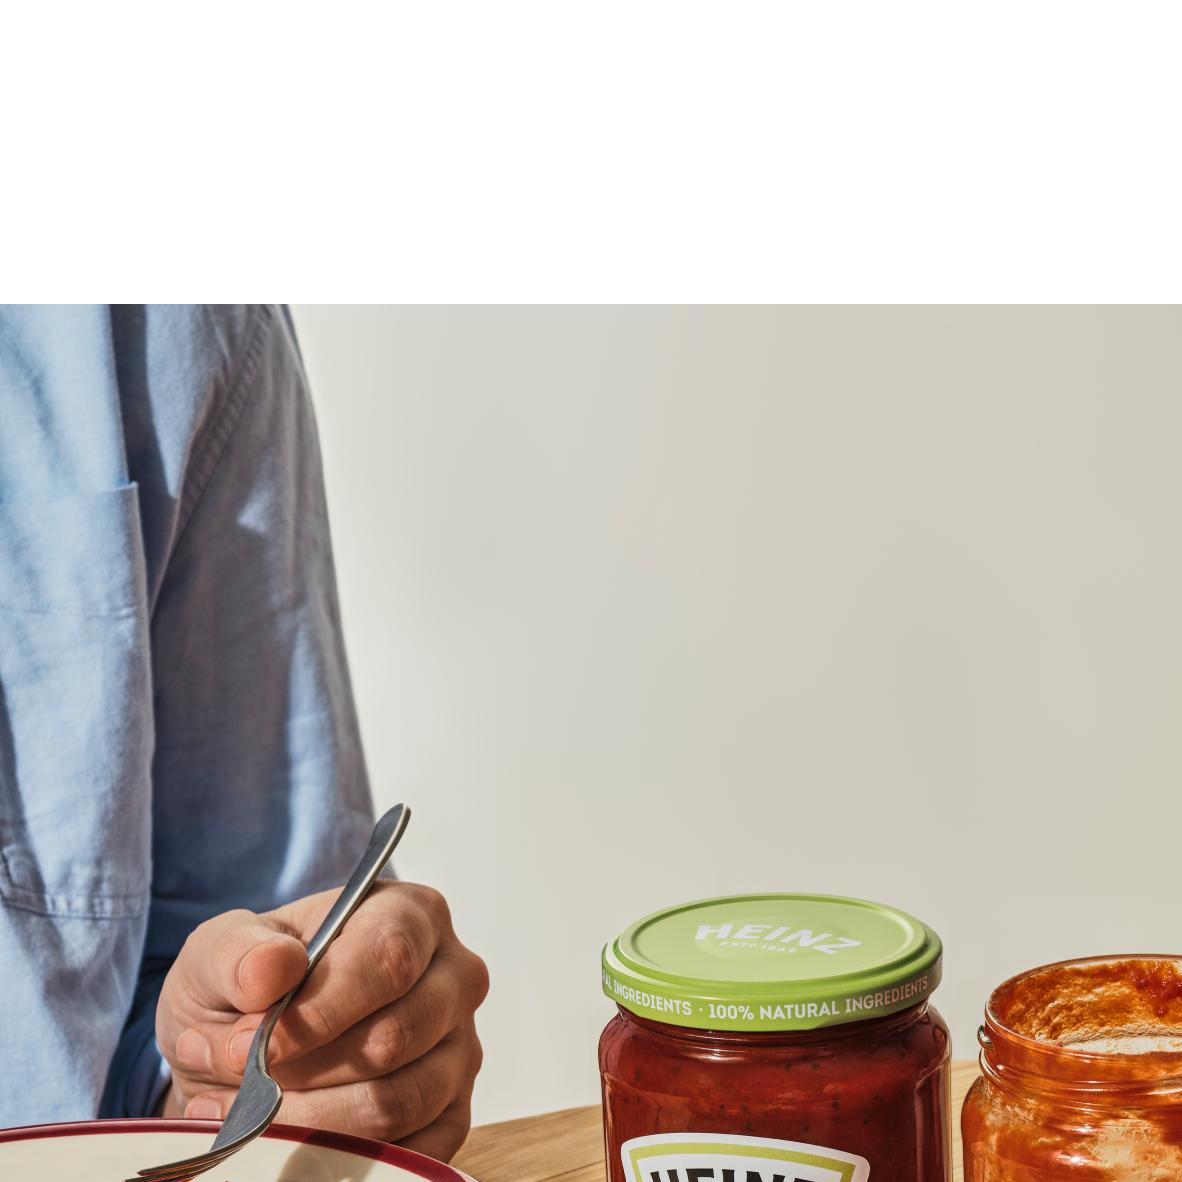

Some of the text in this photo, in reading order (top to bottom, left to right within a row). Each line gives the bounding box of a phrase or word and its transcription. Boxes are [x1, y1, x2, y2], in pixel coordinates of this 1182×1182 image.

[695, 924, 862, 954] HEINZ
[614, 979, 692, 1016] INGREDIENTS
[708, 1003, 754, 1020] 100%
[760, 1000, 839, 1019] NATURAL
[845, 976, 928, 1012] INGREDIENTS
